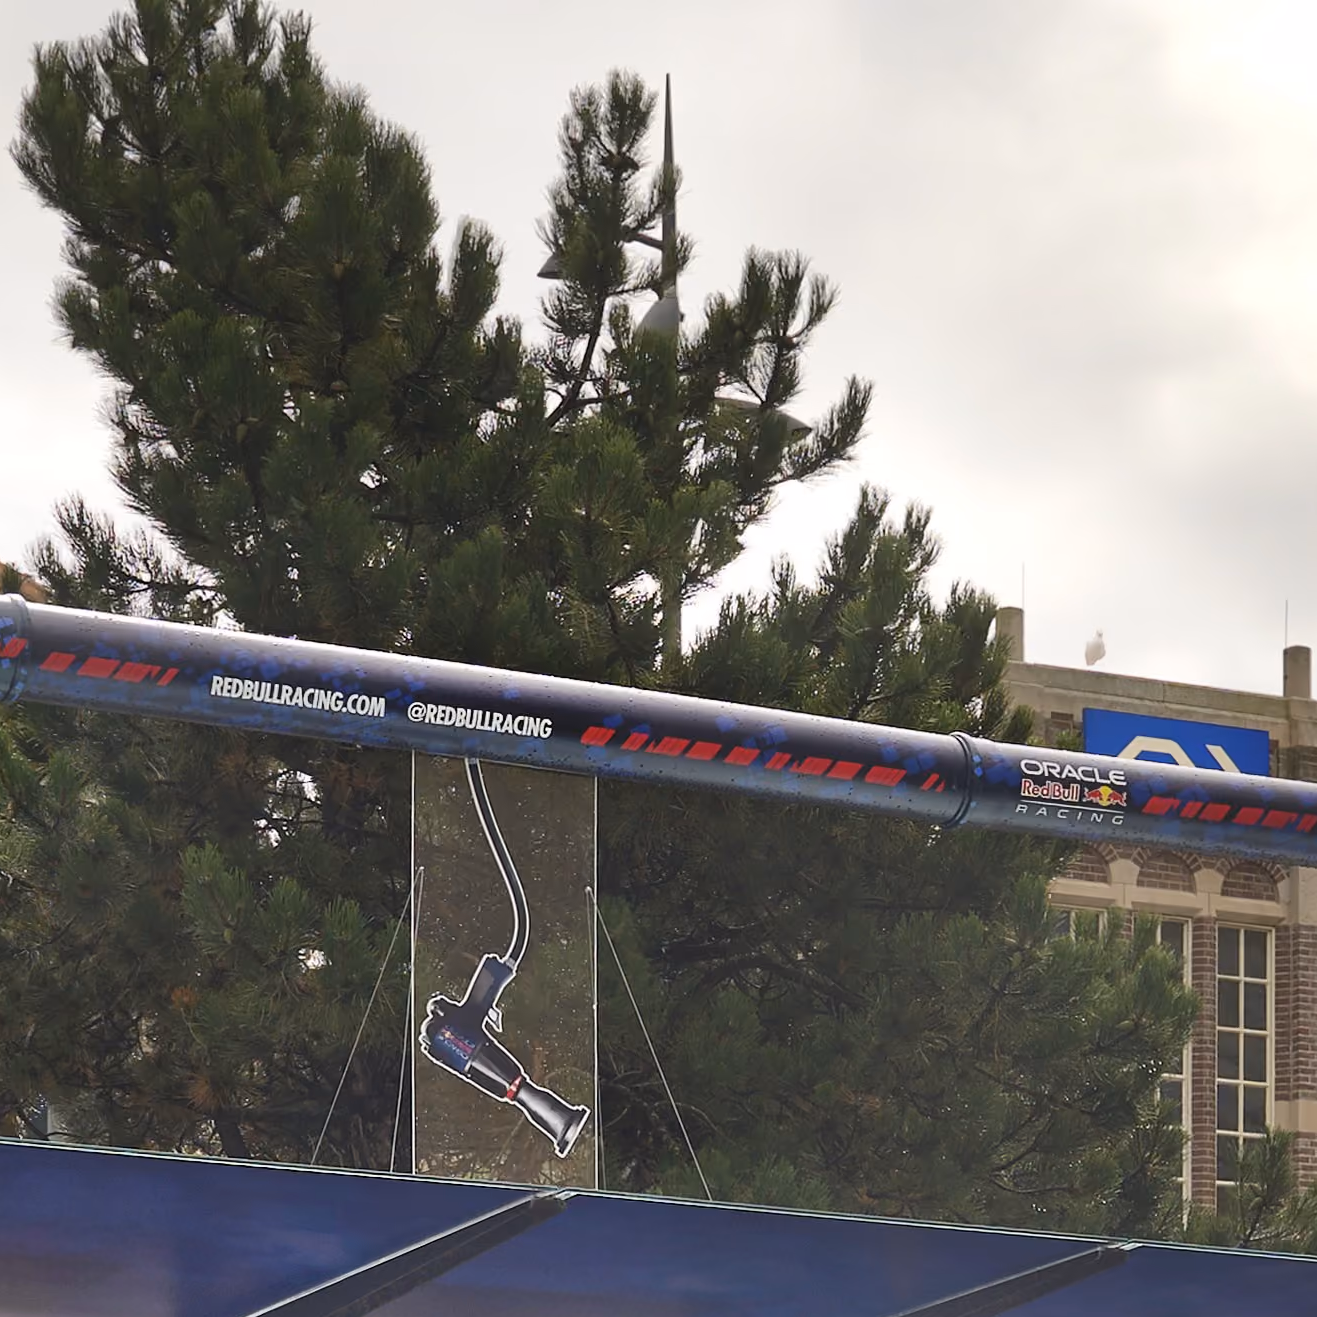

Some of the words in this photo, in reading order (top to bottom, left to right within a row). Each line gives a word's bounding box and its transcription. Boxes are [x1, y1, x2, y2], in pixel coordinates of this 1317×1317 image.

[211, 675, 386, 718] REDBULLRACING.COM
[407, 701, 553, 739] @REDBULLRACING
[1020, 759, 1127, 786] ORACLE
[1015, 804, 1124, 825] RACING
